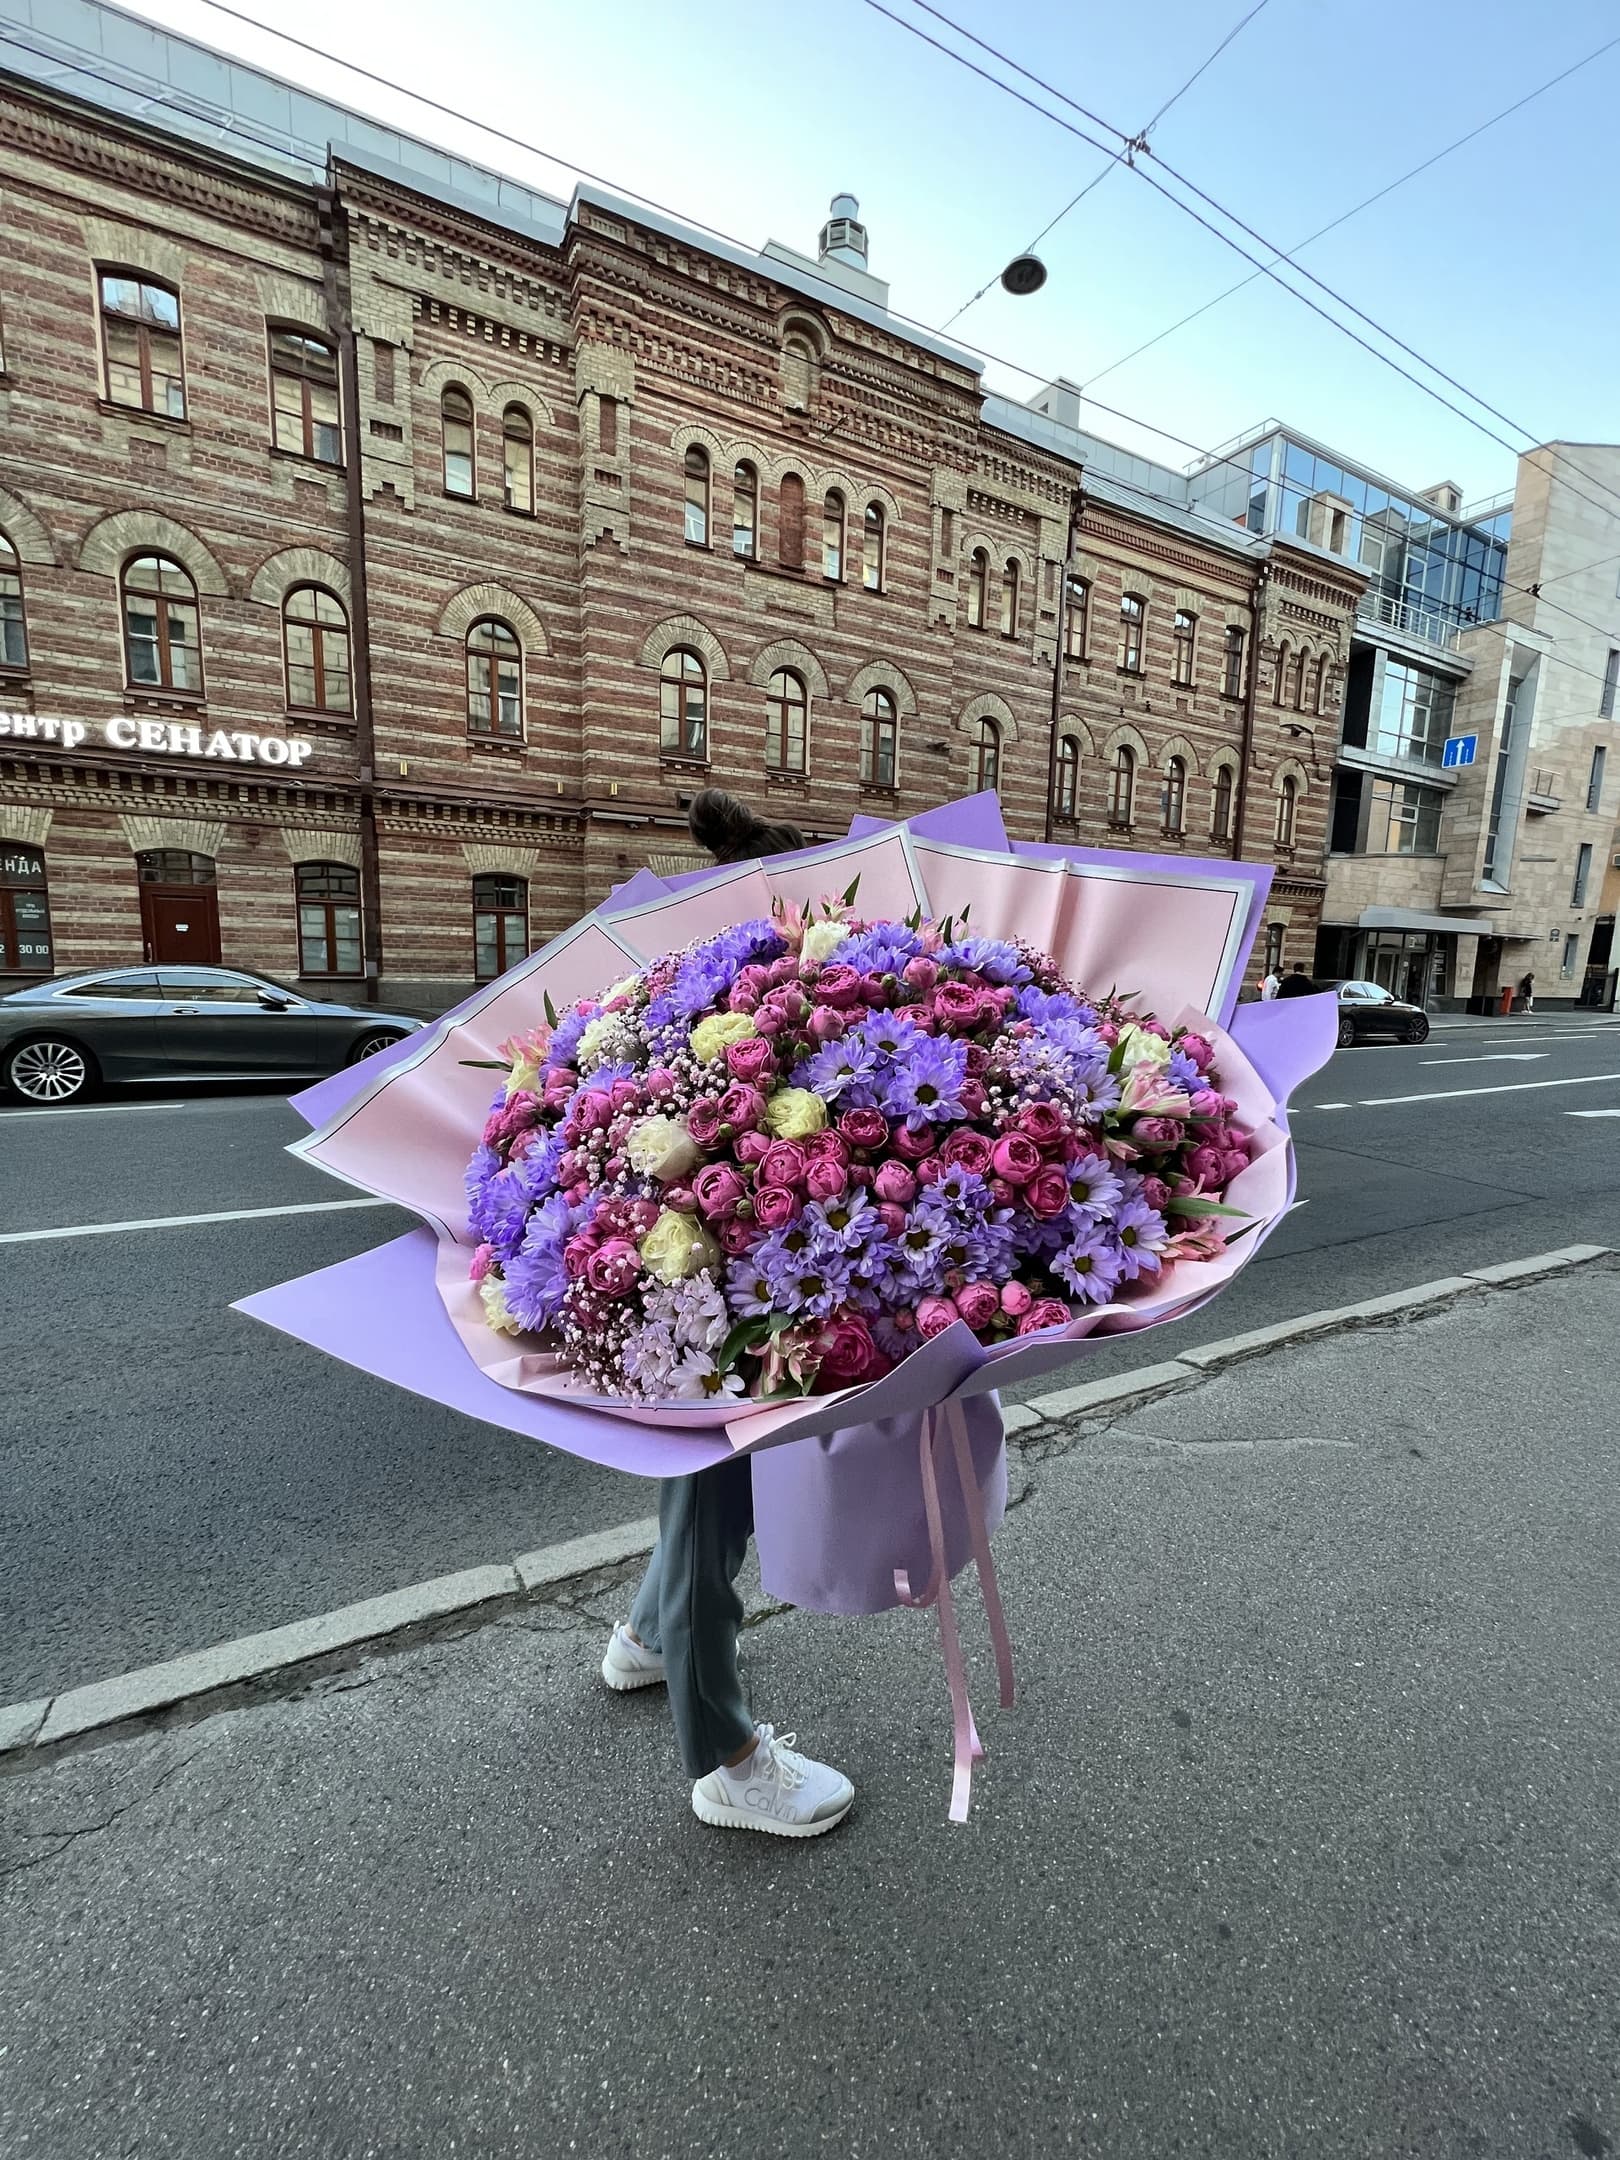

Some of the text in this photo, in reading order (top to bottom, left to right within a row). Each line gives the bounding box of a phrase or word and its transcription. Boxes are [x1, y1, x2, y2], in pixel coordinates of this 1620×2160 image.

[106, 718, 312, 766] СЕНАТОР
[0, 858, 42, 874] НДА
[19, 944, 33, 954] 30
[35, 945, 49, 954] 00
[744, 1787, 798, 1822] Calvin
